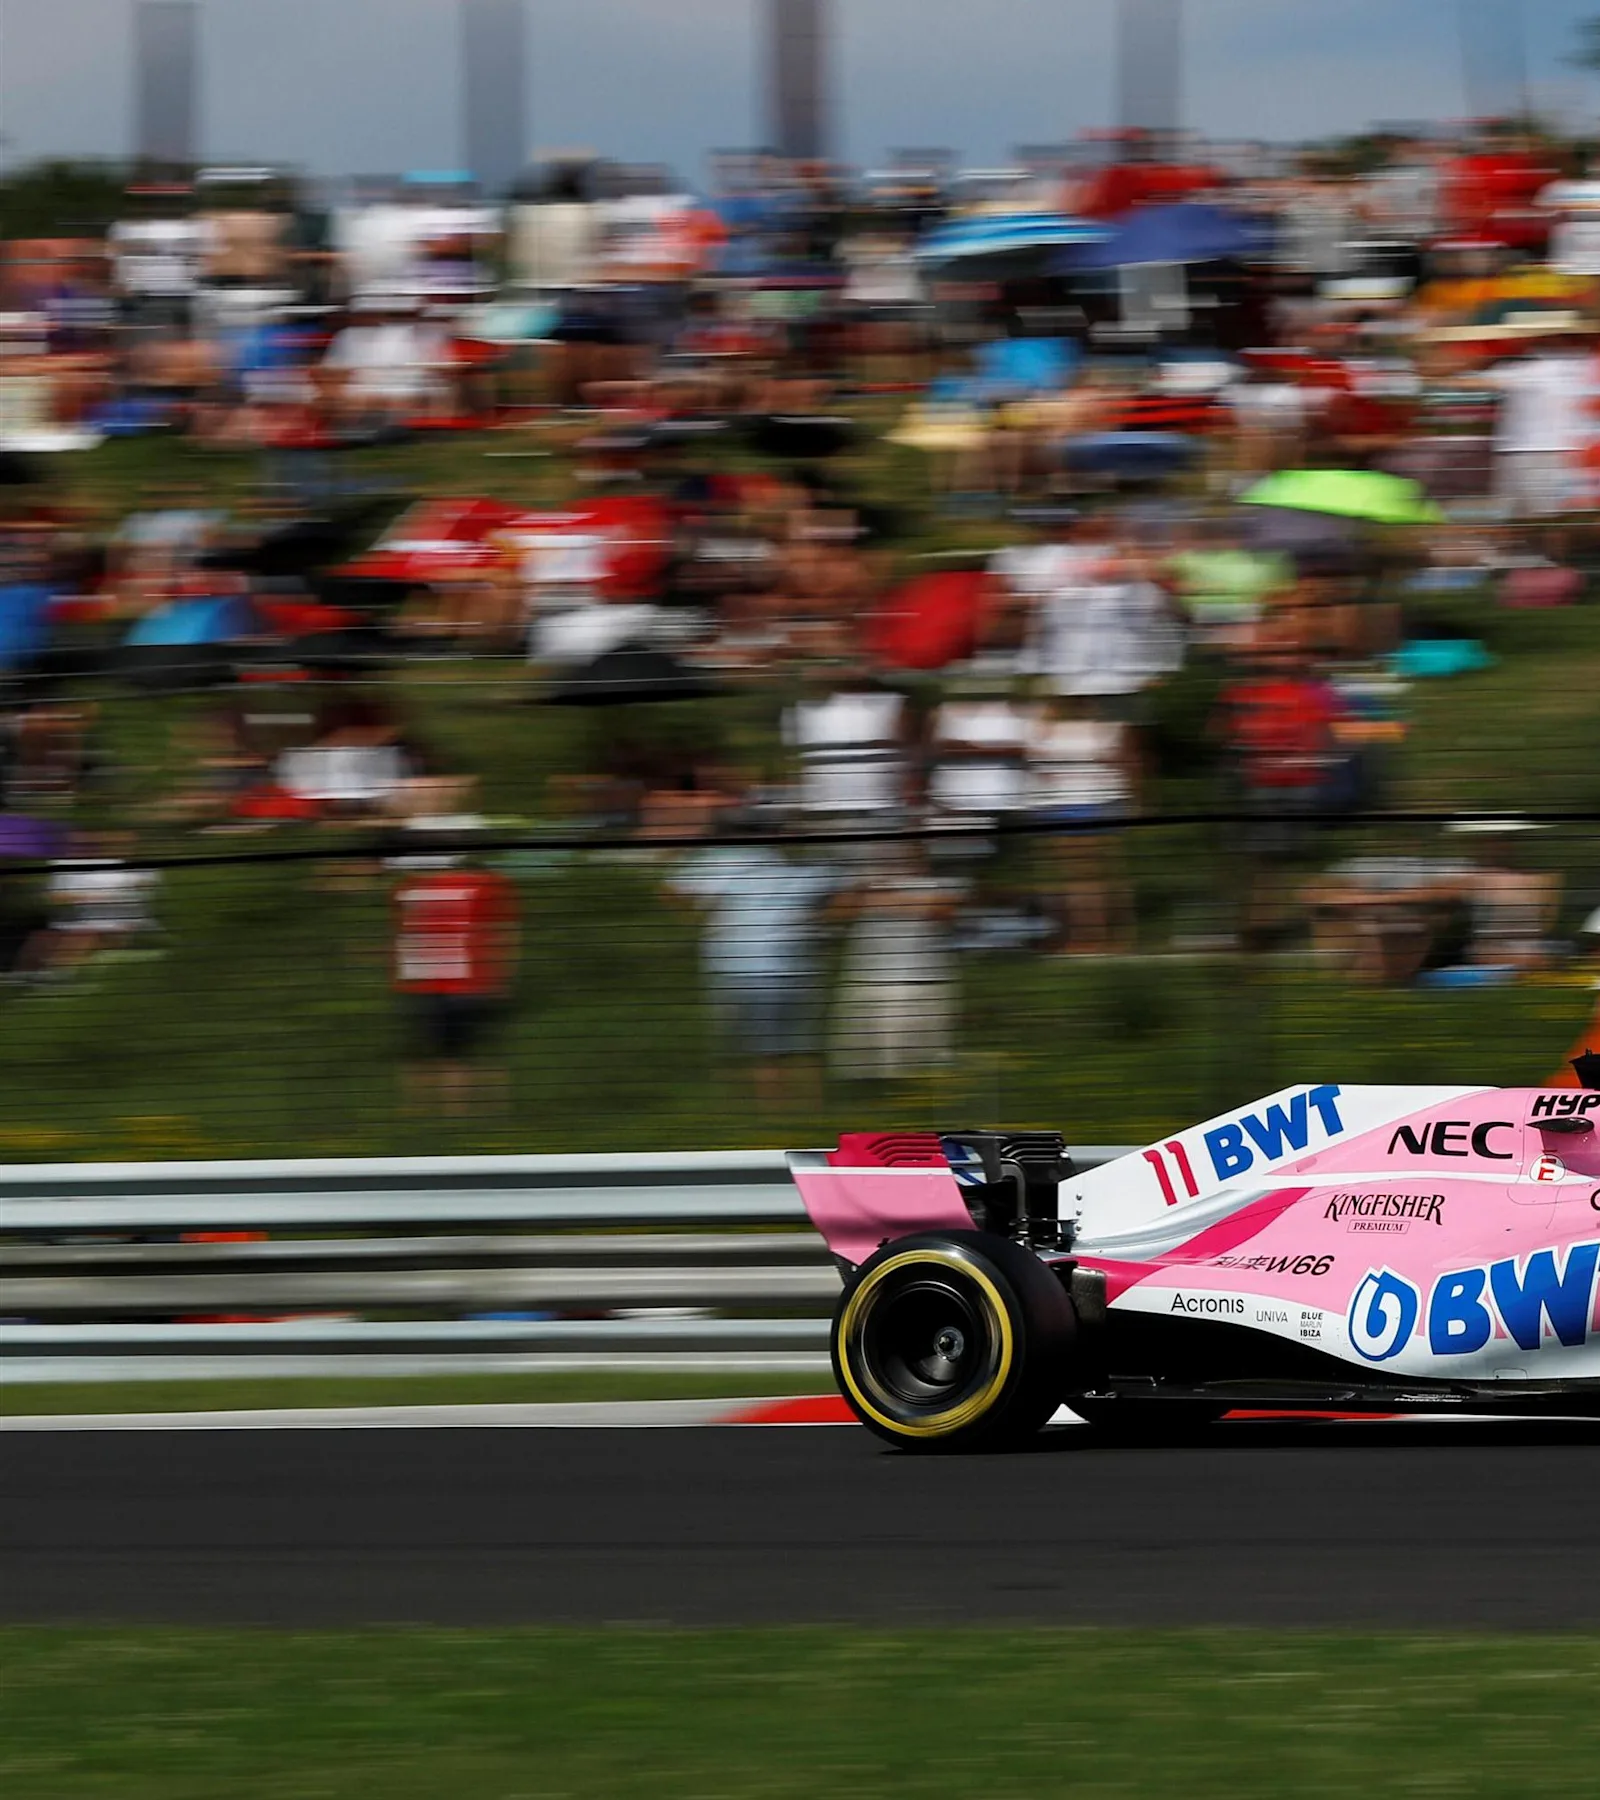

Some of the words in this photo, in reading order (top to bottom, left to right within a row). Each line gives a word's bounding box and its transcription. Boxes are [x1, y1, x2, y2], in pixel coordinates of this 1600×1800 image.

[1204, 1083, 1344, 1181] BWT
[1387, 1121, 1514, 1159] NEC
[1142, 1140, 1199, 1206] 11
[1323, 1194, 1446, 1226] KINGFISHER
[1353, 1222, 1404, 1232] PREMIUM
[1171, 1293, 1244, 1313] Acronis
[1256, 1310, 1288, 1322] UNIVA
[1301, 1312, 1323, 1320] BLUE
[1300, 1329, 1321, 1337] IBIZA
